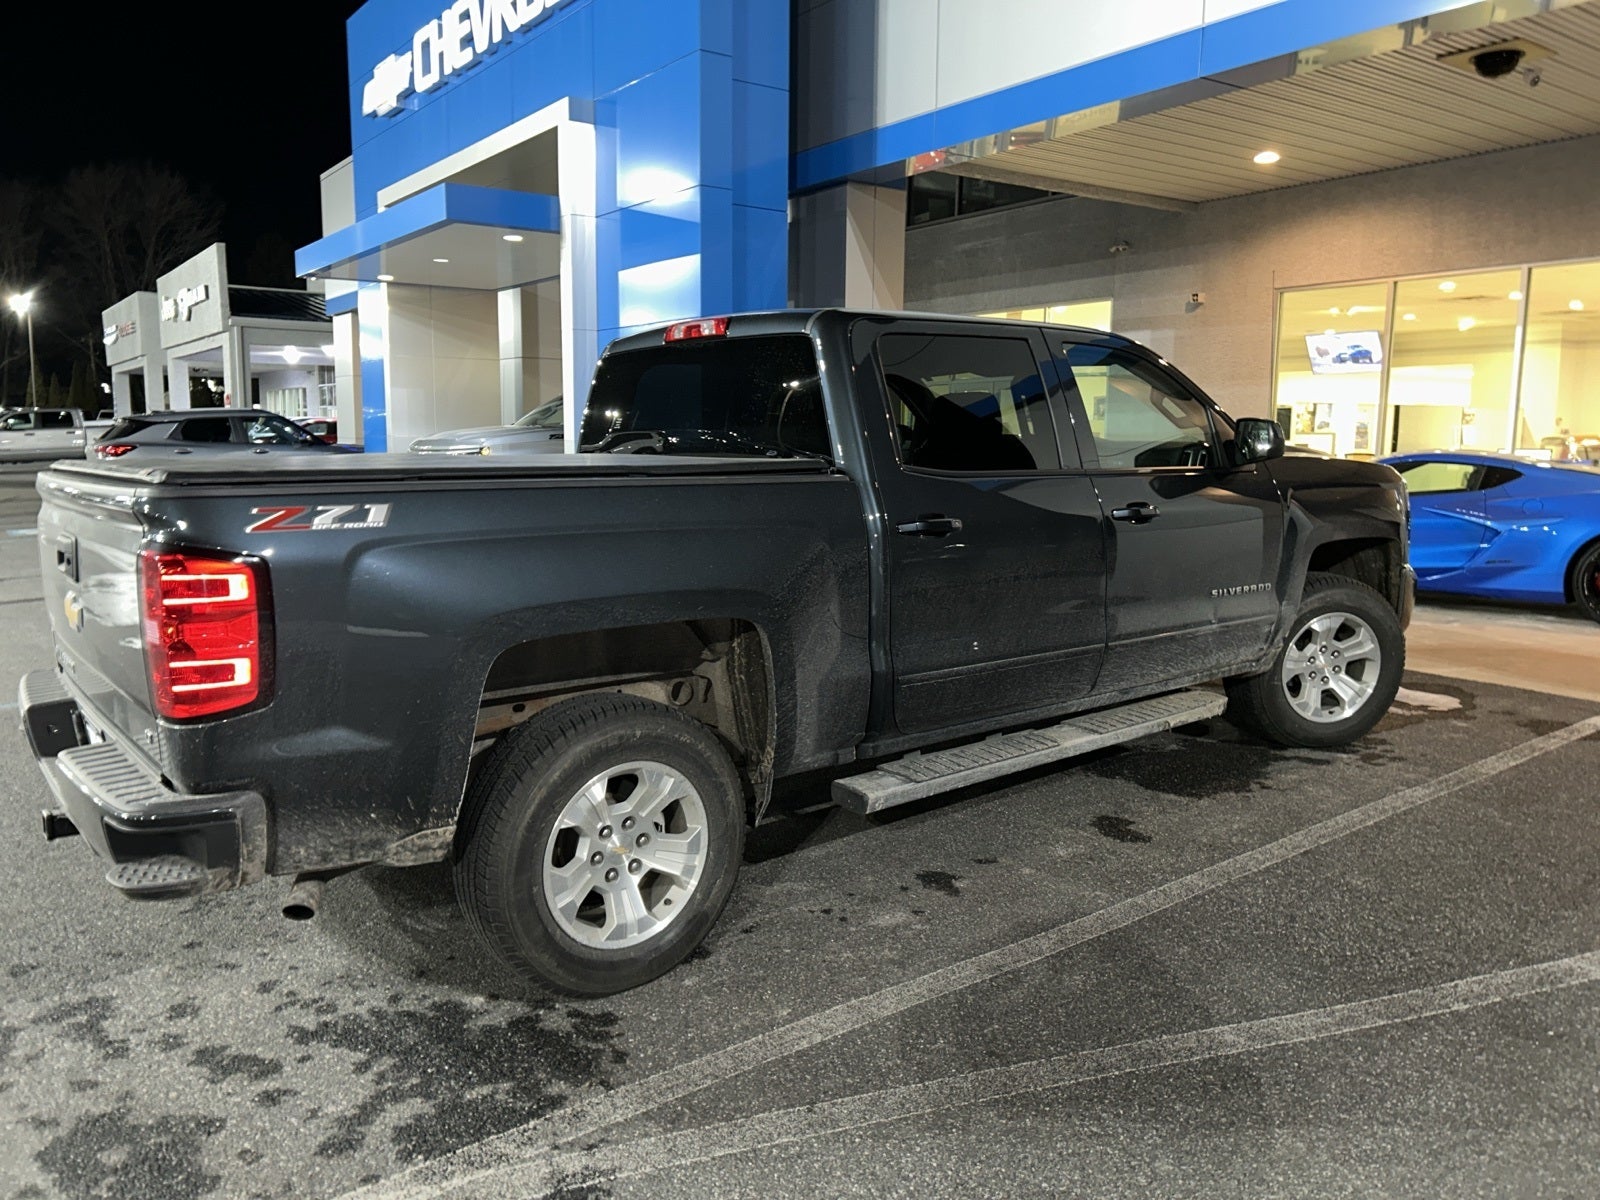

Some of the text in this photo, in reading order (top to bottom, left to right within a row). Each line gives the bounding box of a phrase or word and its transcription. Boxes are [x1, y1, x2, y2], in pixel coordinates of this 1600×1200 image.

[413, 0, 560, 93] CHEVR
[244, 503, 391, 534] Z71
[1211, 582, 1272, 598] SILVERADO
